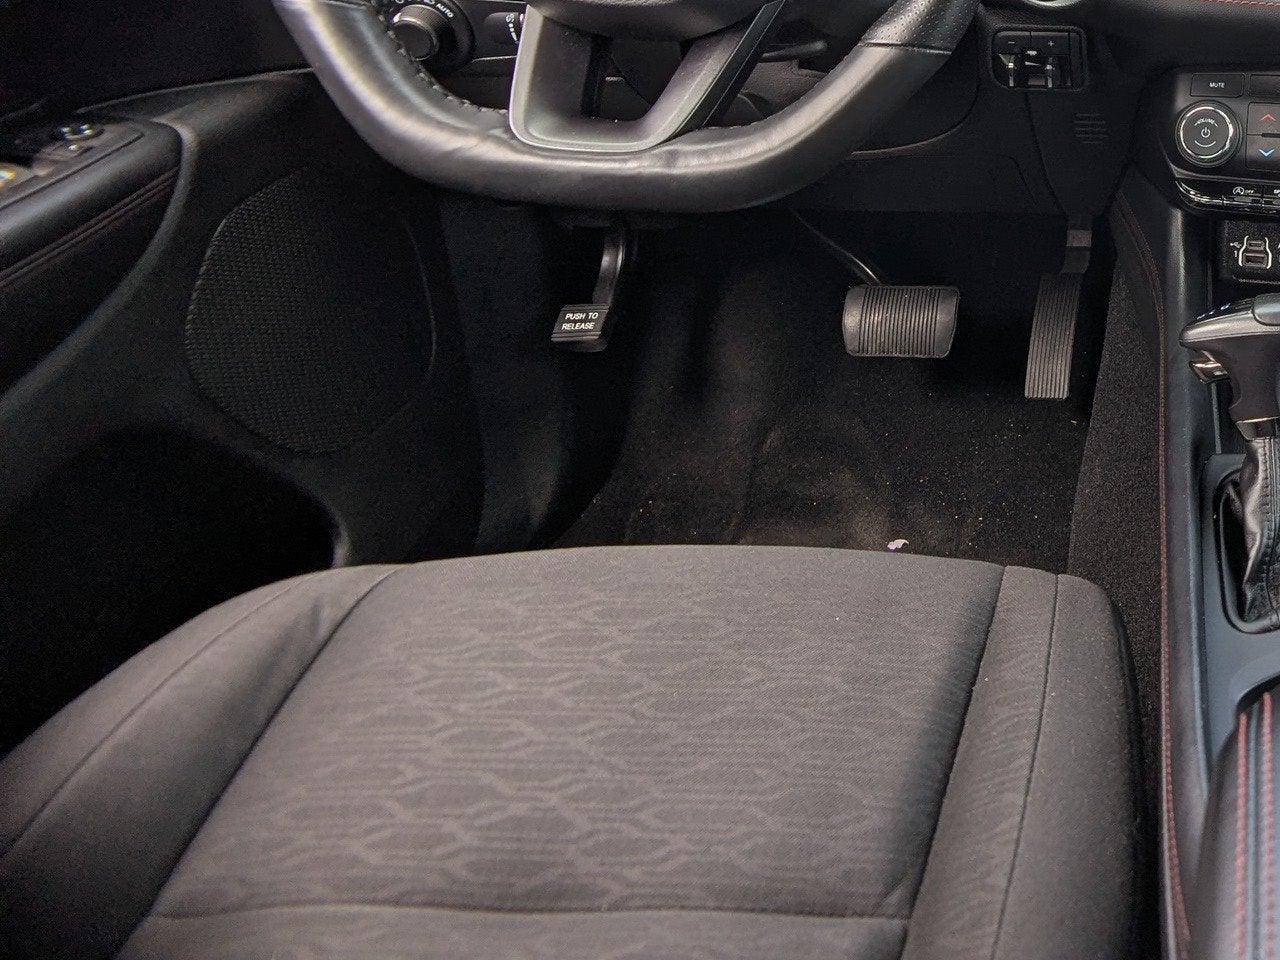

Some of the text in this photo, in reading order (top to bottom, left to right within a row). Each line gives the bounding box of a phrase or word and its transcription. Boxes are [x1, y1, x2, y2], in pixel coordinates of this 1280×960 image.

[435, 3, 454, 18] AUTO
[1233, 250, 1238, 258] 1
[565, 312, 599, 320] PUSH TO
[561, 322, 596, 330] RELEASE
